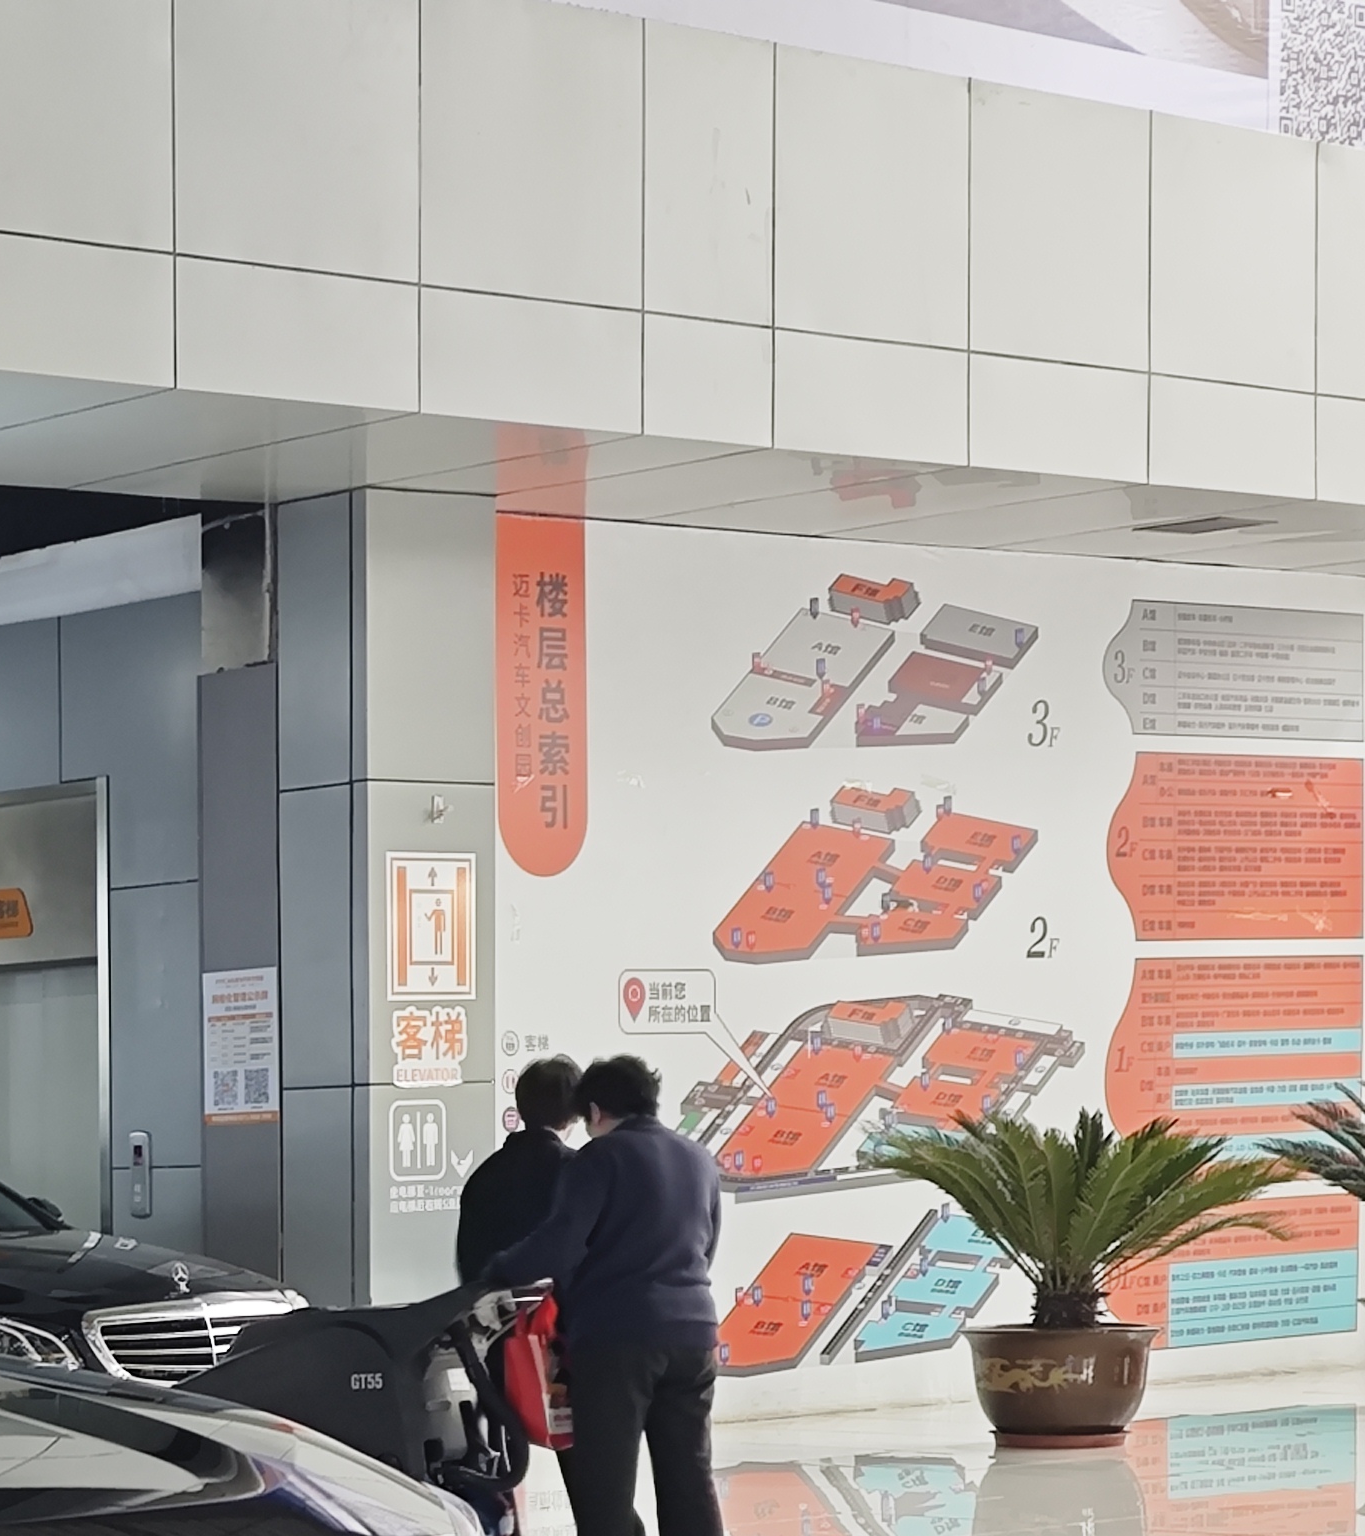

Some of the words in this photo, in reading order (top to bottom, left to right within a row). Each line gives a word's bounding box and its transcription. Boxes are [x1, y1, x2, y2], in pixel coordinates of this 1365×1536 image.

[512, 574, 532, 778] 迈卡汽车文创园
[1114, 650, 1135, 684] 3F
[536, 571, 570, 829] 楼层总索引
[1027, 699, 1061, 748] 3F
[1026, 916, 1060, 958] 2F
[648, 982, 686, 1001] 当前您
[648, 1003, 712, 1024] 所在的位置
[396, 1012, 464, 1061] 客梯
[525, 1034, 549, 1052] 客梯
[396, 1067, 459, 1083] ELEVATOR
[935, 1277, 962, 1290] D馆
[901, 1322, 929, 1334] C馆
[351, 1373, 384, 1390] GT55
